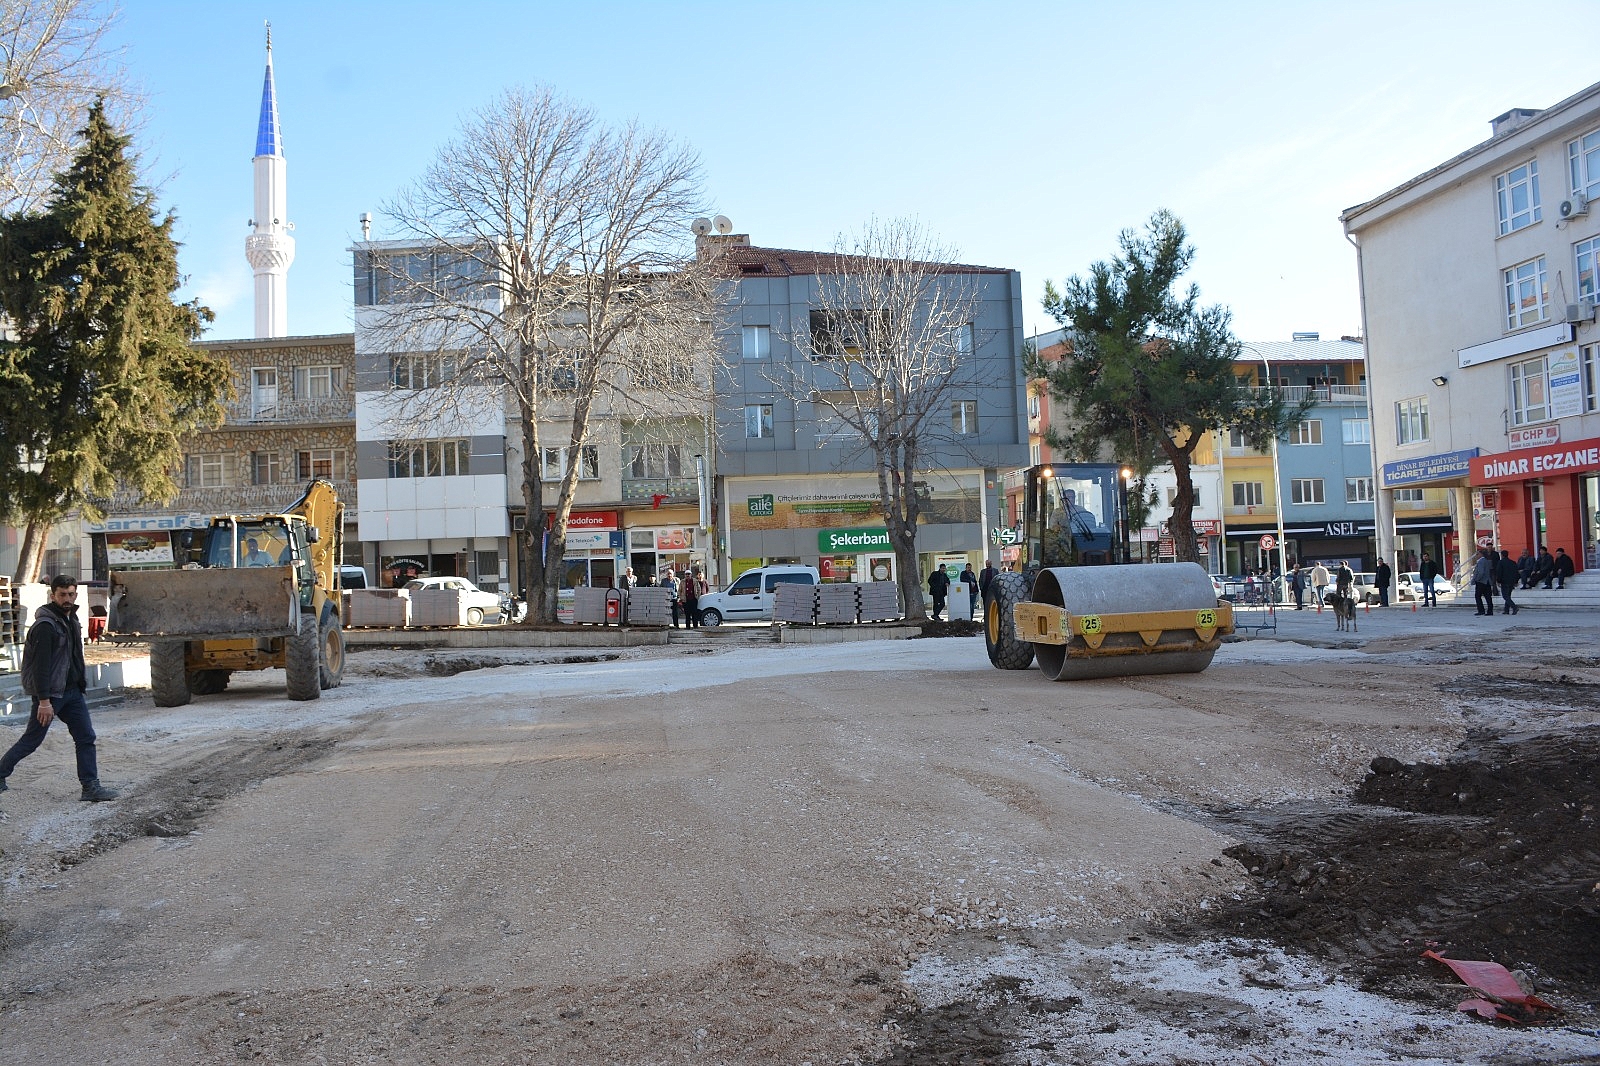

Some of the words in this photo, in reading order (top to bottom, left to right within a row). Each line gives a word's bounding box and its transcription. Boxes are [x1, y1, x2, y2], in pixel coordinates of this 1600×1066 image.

[1522, 429, 1544, 441] CHP
[1396, 462, 1418, 472] DİNAR
[1418, 454, 1460, 468] BELEDİYESİ
[1483, 458, 1530, 479] DİNAR
[1532, 446, 1600, 472] ECZANE
[1386, 467, 1425, 481] TİCARET
[1427, 460, 1470, 475] MERKEZ
[566, 516, 604, 525] vodafone
[1325, 521, 1358, 536] ASEL
[1085, 618, 1098, 630] 25
[1200, 613, 1213, 624] 25
